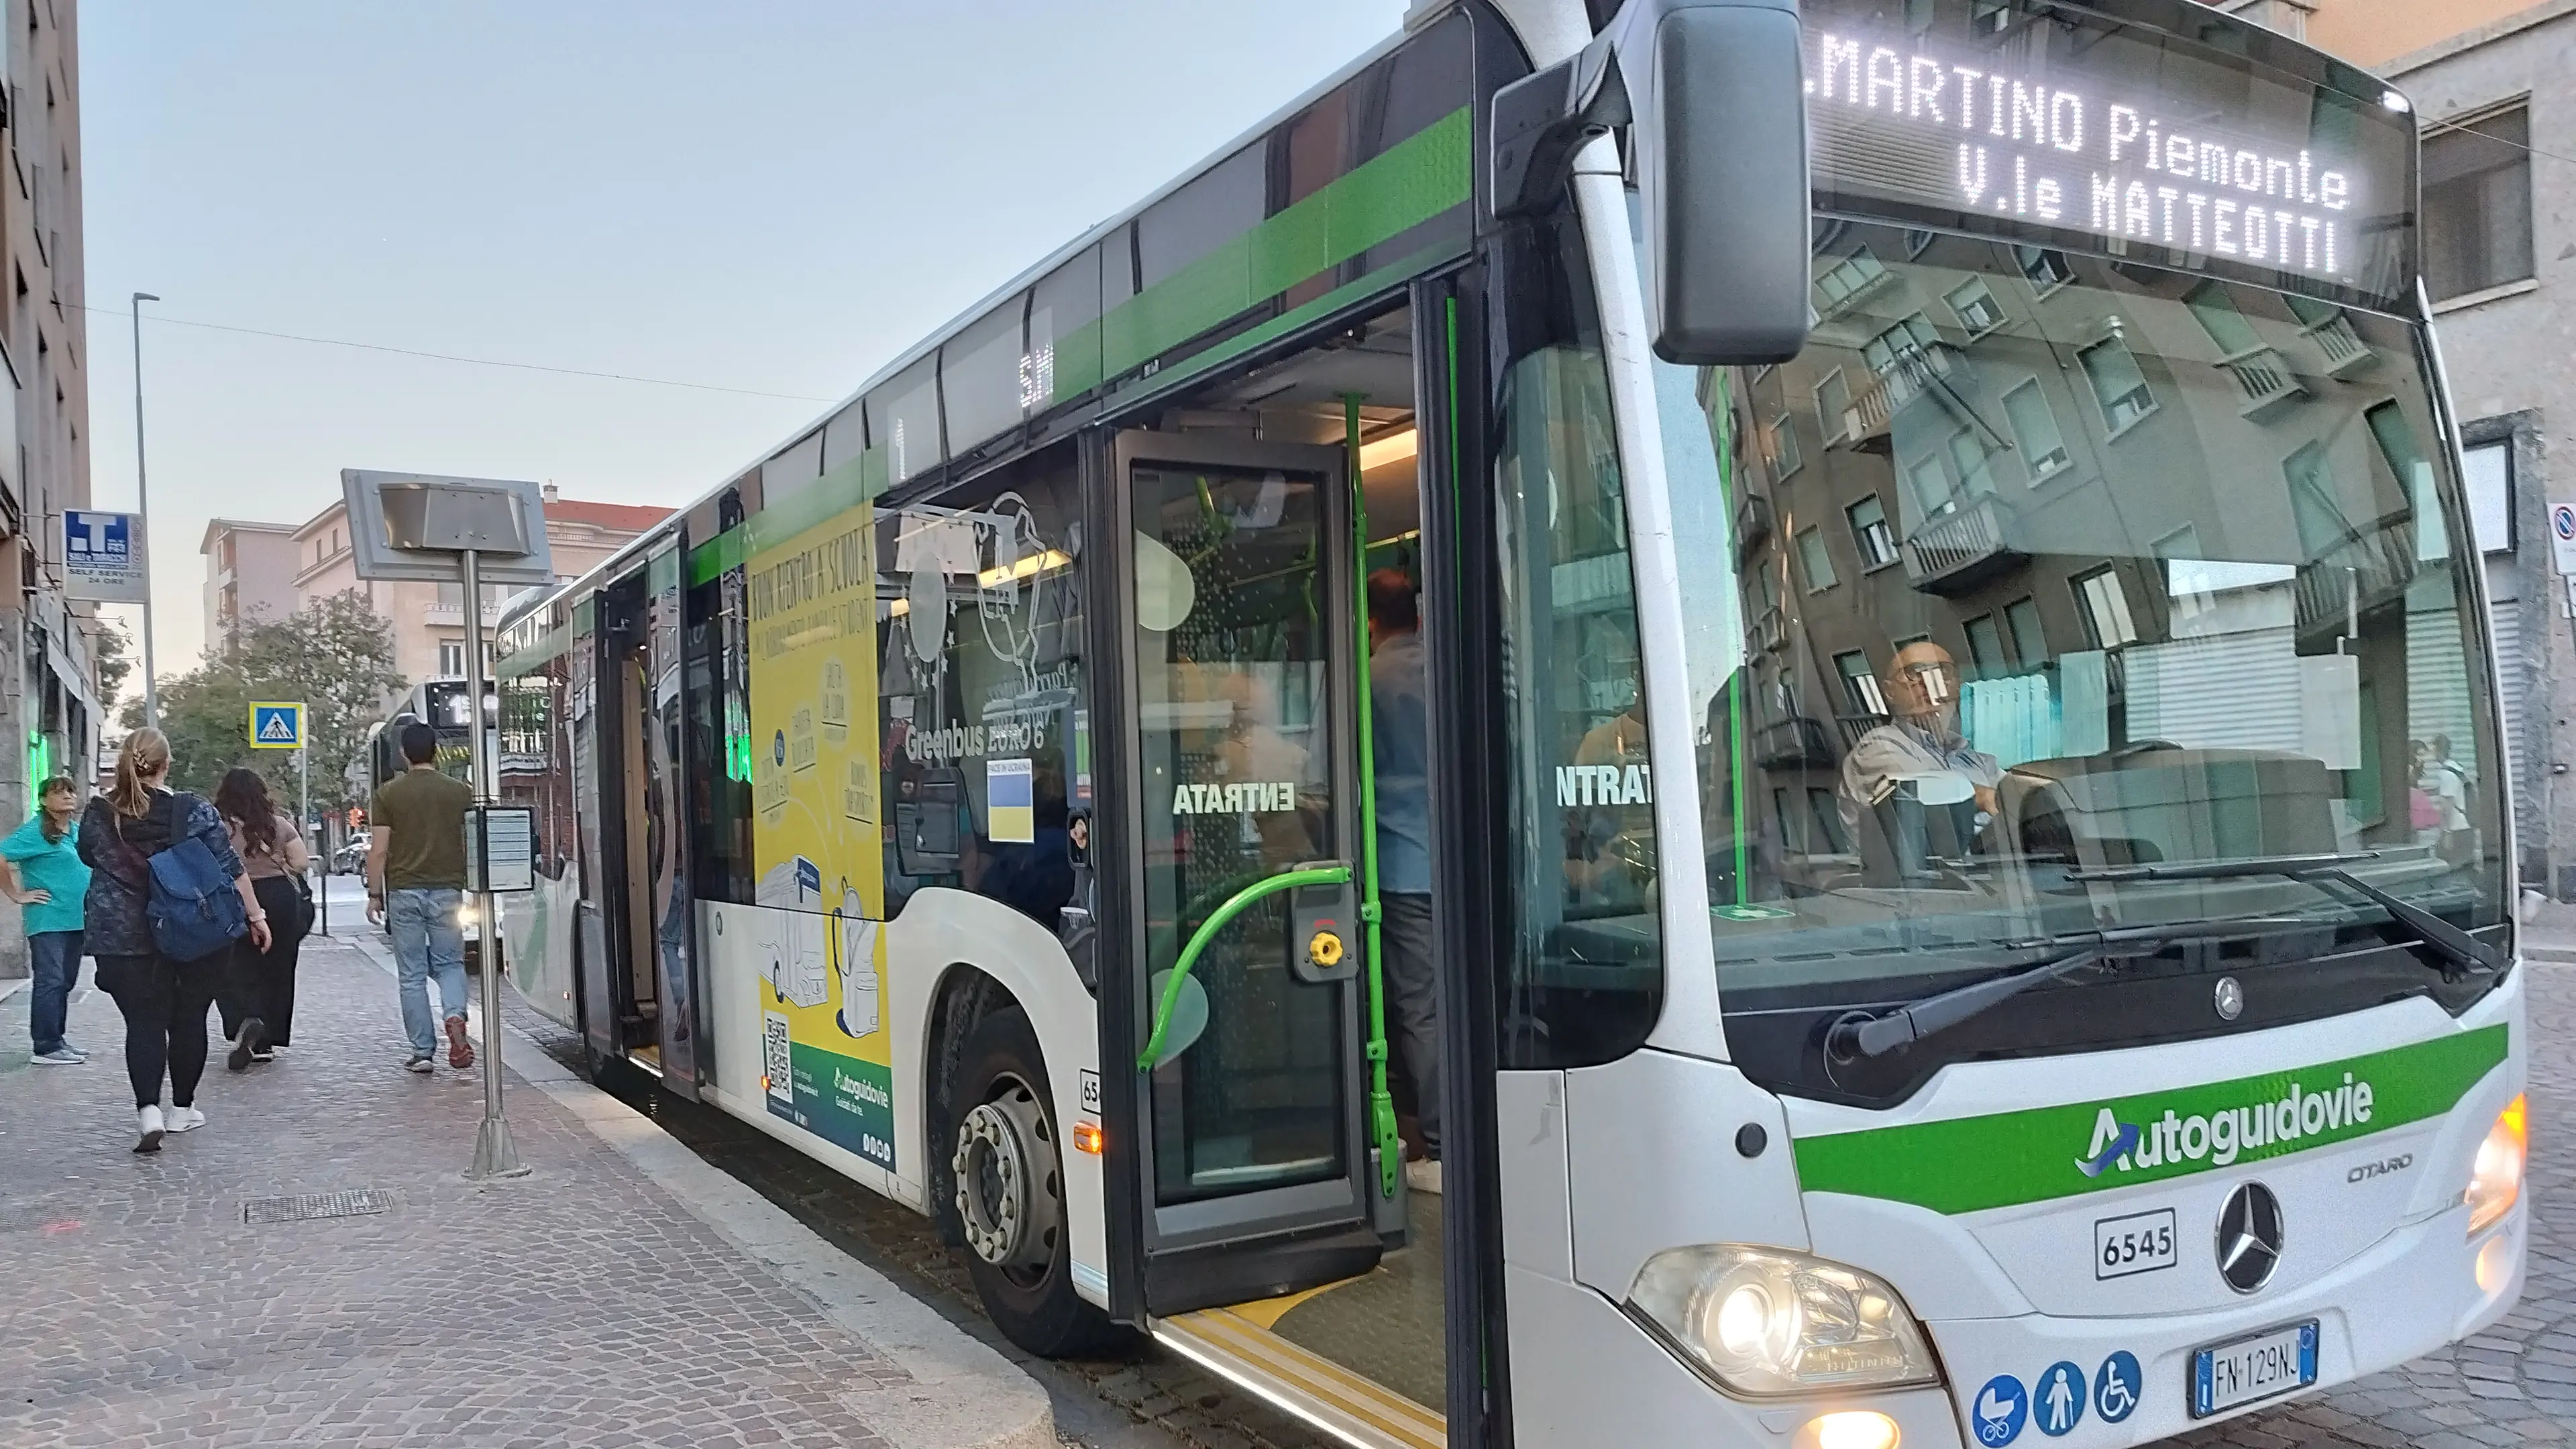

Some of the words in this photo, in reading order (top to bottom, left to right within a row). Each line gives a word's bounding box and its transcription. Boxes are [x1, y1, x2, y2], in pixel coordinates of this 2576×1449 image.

[2109, 104, 2350, 210] Piemonte
[1958, 143, 2061, 219] V.le
[2092, 171, 2335, 273] MATTEOTTI
[98, 570, 143, 578] SERVICE
[906, 718, 984, 761] Greenbus
[1034, 721, 1044, 749] 6
[834, 1067, 889, 1108] Autoguidovie
[1084, 1080, 1100, 1102] 65
[2075, 1072, 2374, 1178] Autoguidovie
[2103, 1226, 2172, 1266] 6545
